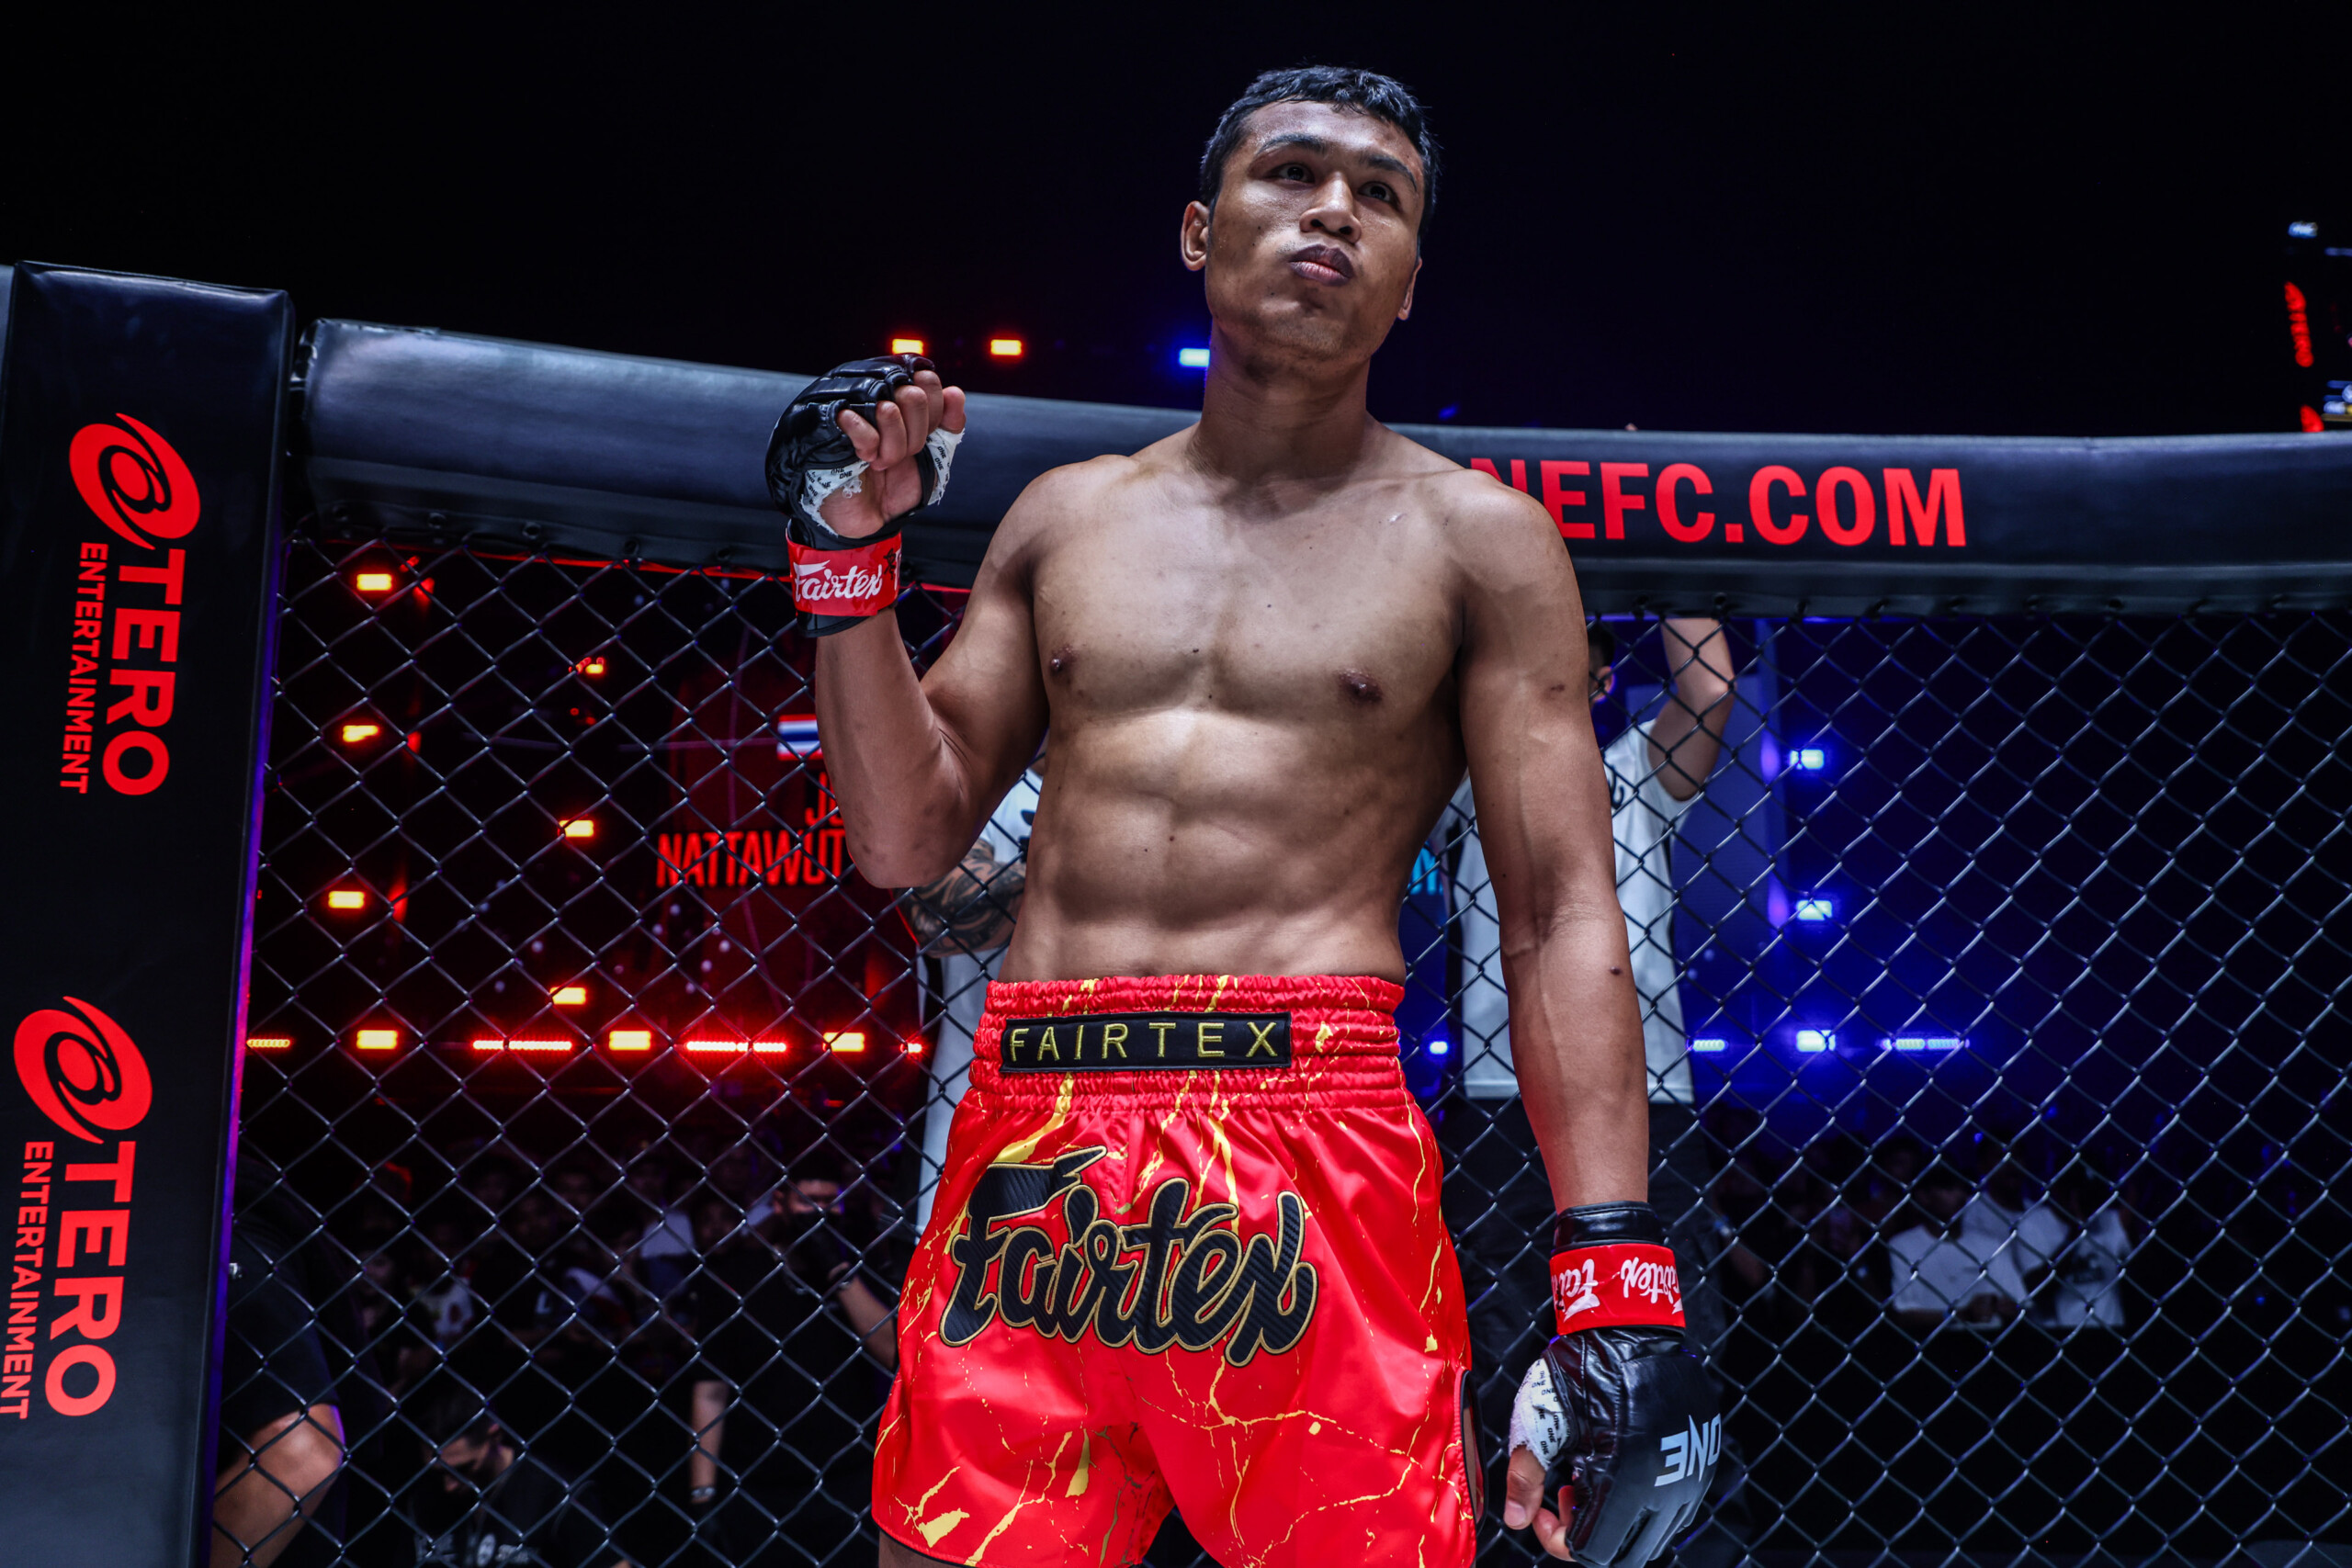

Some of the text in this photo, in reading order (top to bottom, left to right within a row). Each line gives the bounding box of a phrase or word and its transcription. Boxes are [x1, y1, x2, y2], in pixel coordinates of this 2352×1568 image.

[60, 542, 108, 794] ENTERTAINMENT
[102, 548, 186, 796] TERO
[793, 559, 883, 603] Fairtex
[656, 828, 845, 888] NATTAWUT
[1010, 1021, 1277, 1062] FAIRTEX
[0, 1141, 54, 1419] ENTERTAINMENT
[44, 1141, 136, 1417] TERO
[939, 1145, 1320, 1368] Fairtex
[1655, 1413, 1722, 1487] ONE
